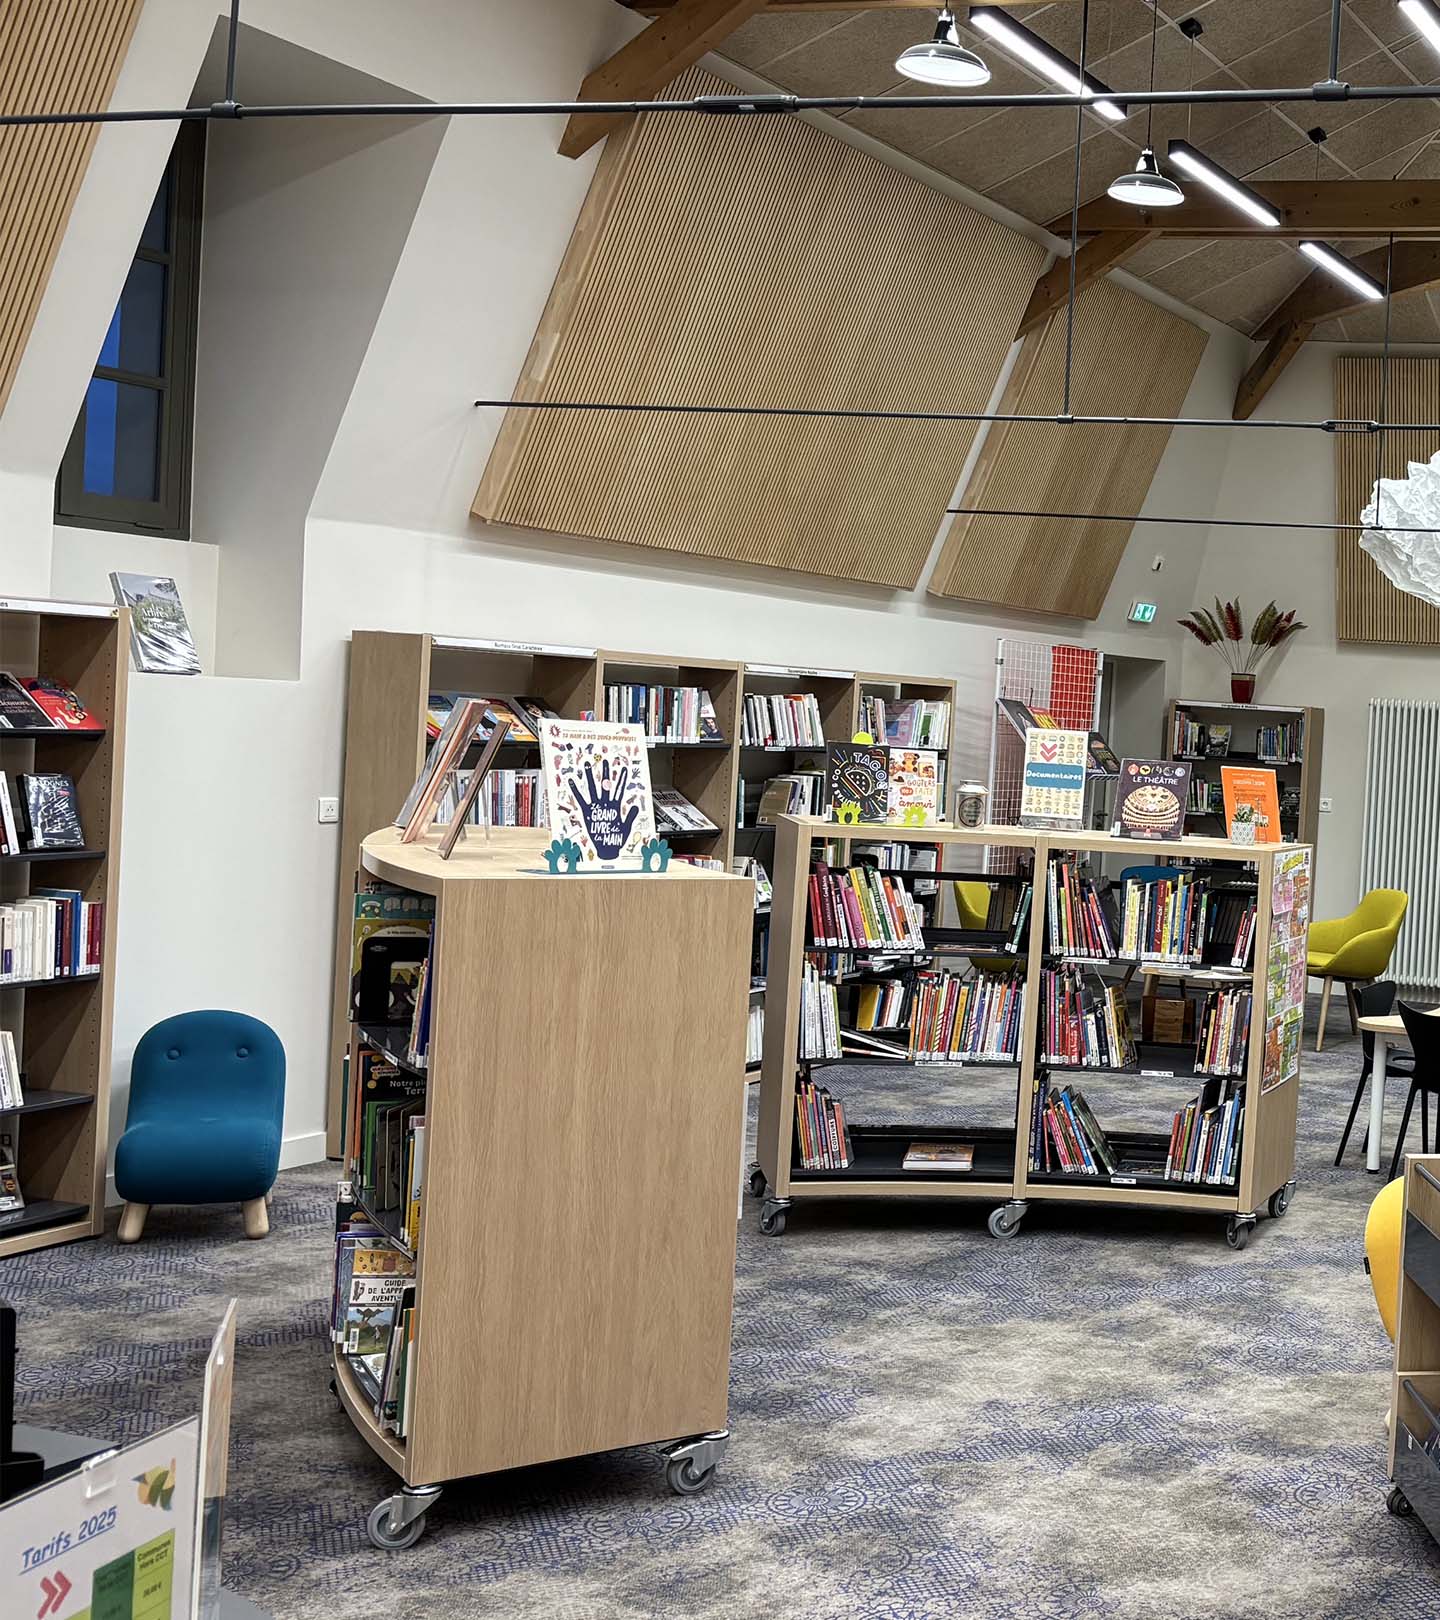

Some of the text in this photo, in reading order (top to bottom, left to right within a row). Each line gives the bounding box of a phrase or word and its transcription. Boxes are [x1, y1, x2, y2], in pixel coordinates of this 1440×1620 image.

[1026, 769, 1083, 782] Documentaires
[1133, 774, 1179, 786] LE THÉÂTRE
[591, 808, 618, 822] GRAND
[590, 822, 611, 834] LIVRE
[603, 833, 623, 846] MAIN
[389, 1080, 415, 1088] Notre
[384, 1279, 407, 1287] GUIDE
[367, 1287, 377, 1295] DE
[22, 1505, 117, 1569] Tarifs 2025
